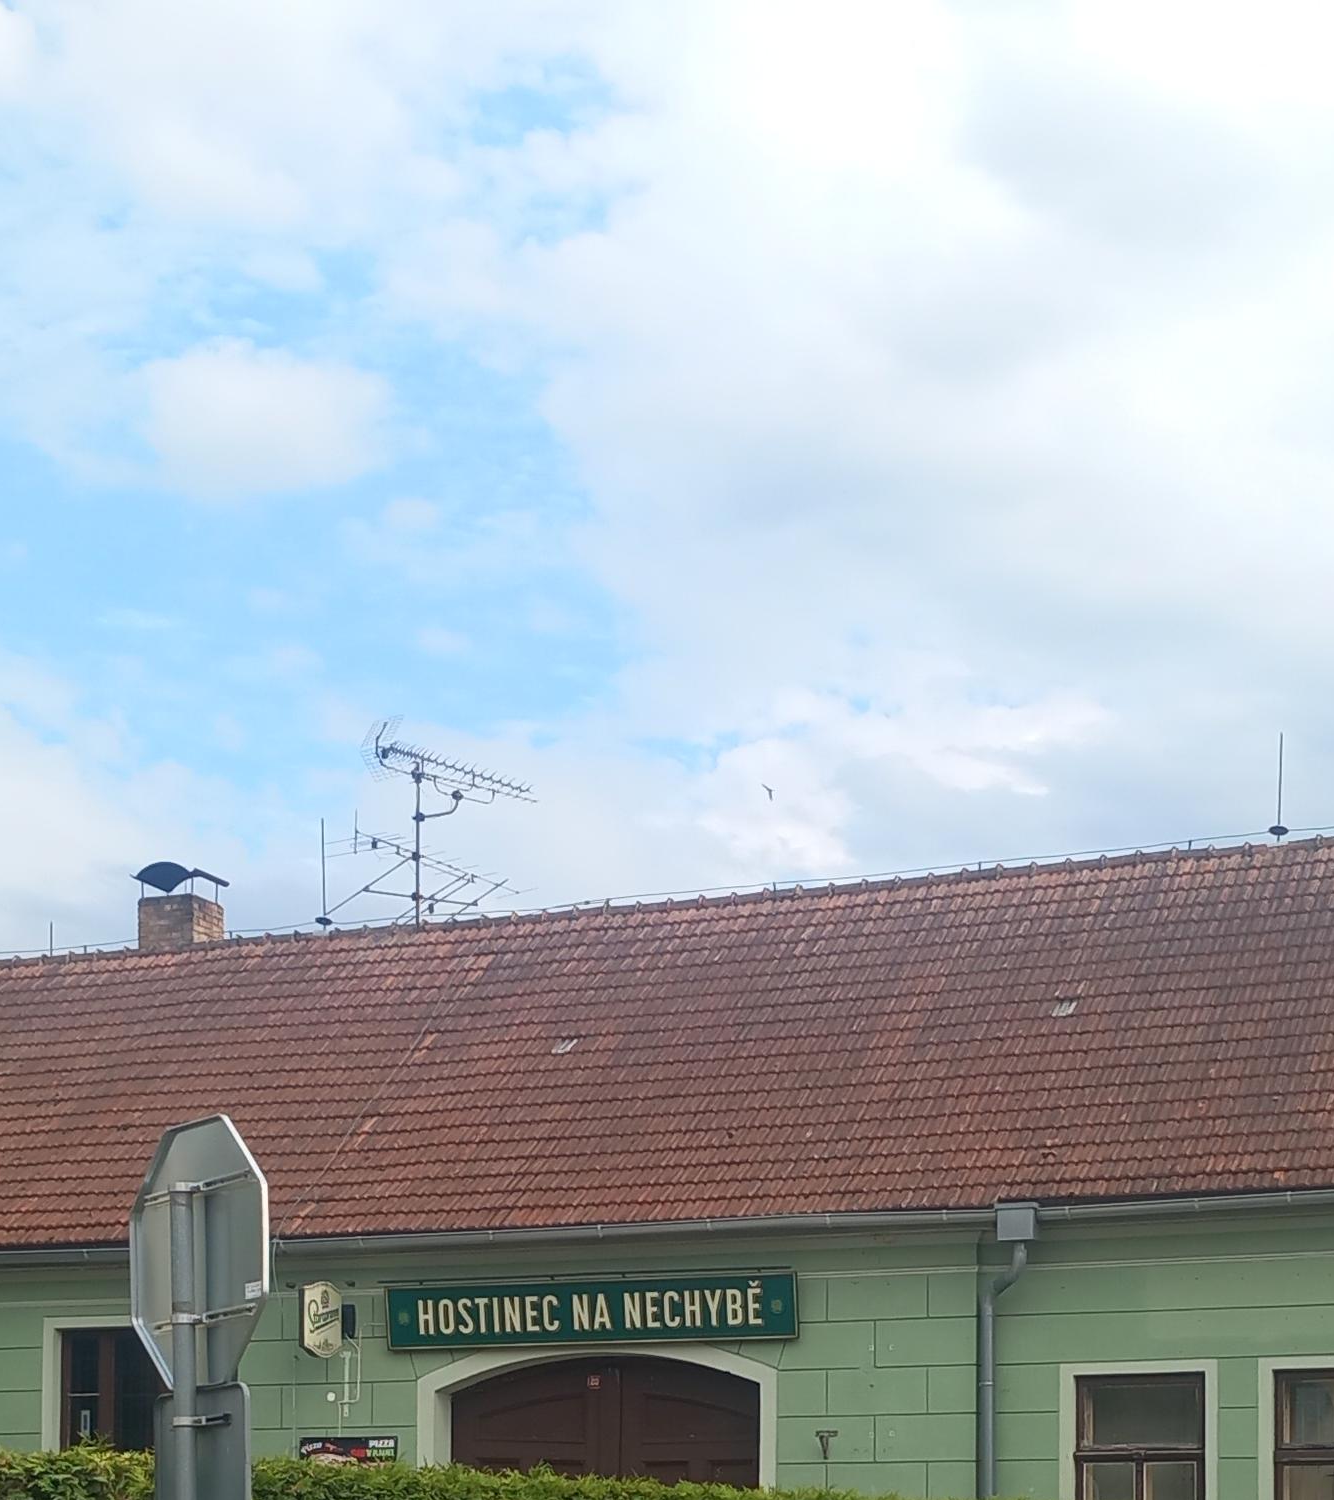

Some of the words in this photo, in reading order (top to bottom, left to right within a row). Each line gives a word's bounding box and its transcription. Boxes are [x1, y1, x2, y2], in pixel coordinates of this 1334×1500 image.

[417, 1295, 560, 1336] HOSTINEC
[572, 1293, 612, 1331] NA
[623, 1280, 763, 1330] NECHYBĚ
